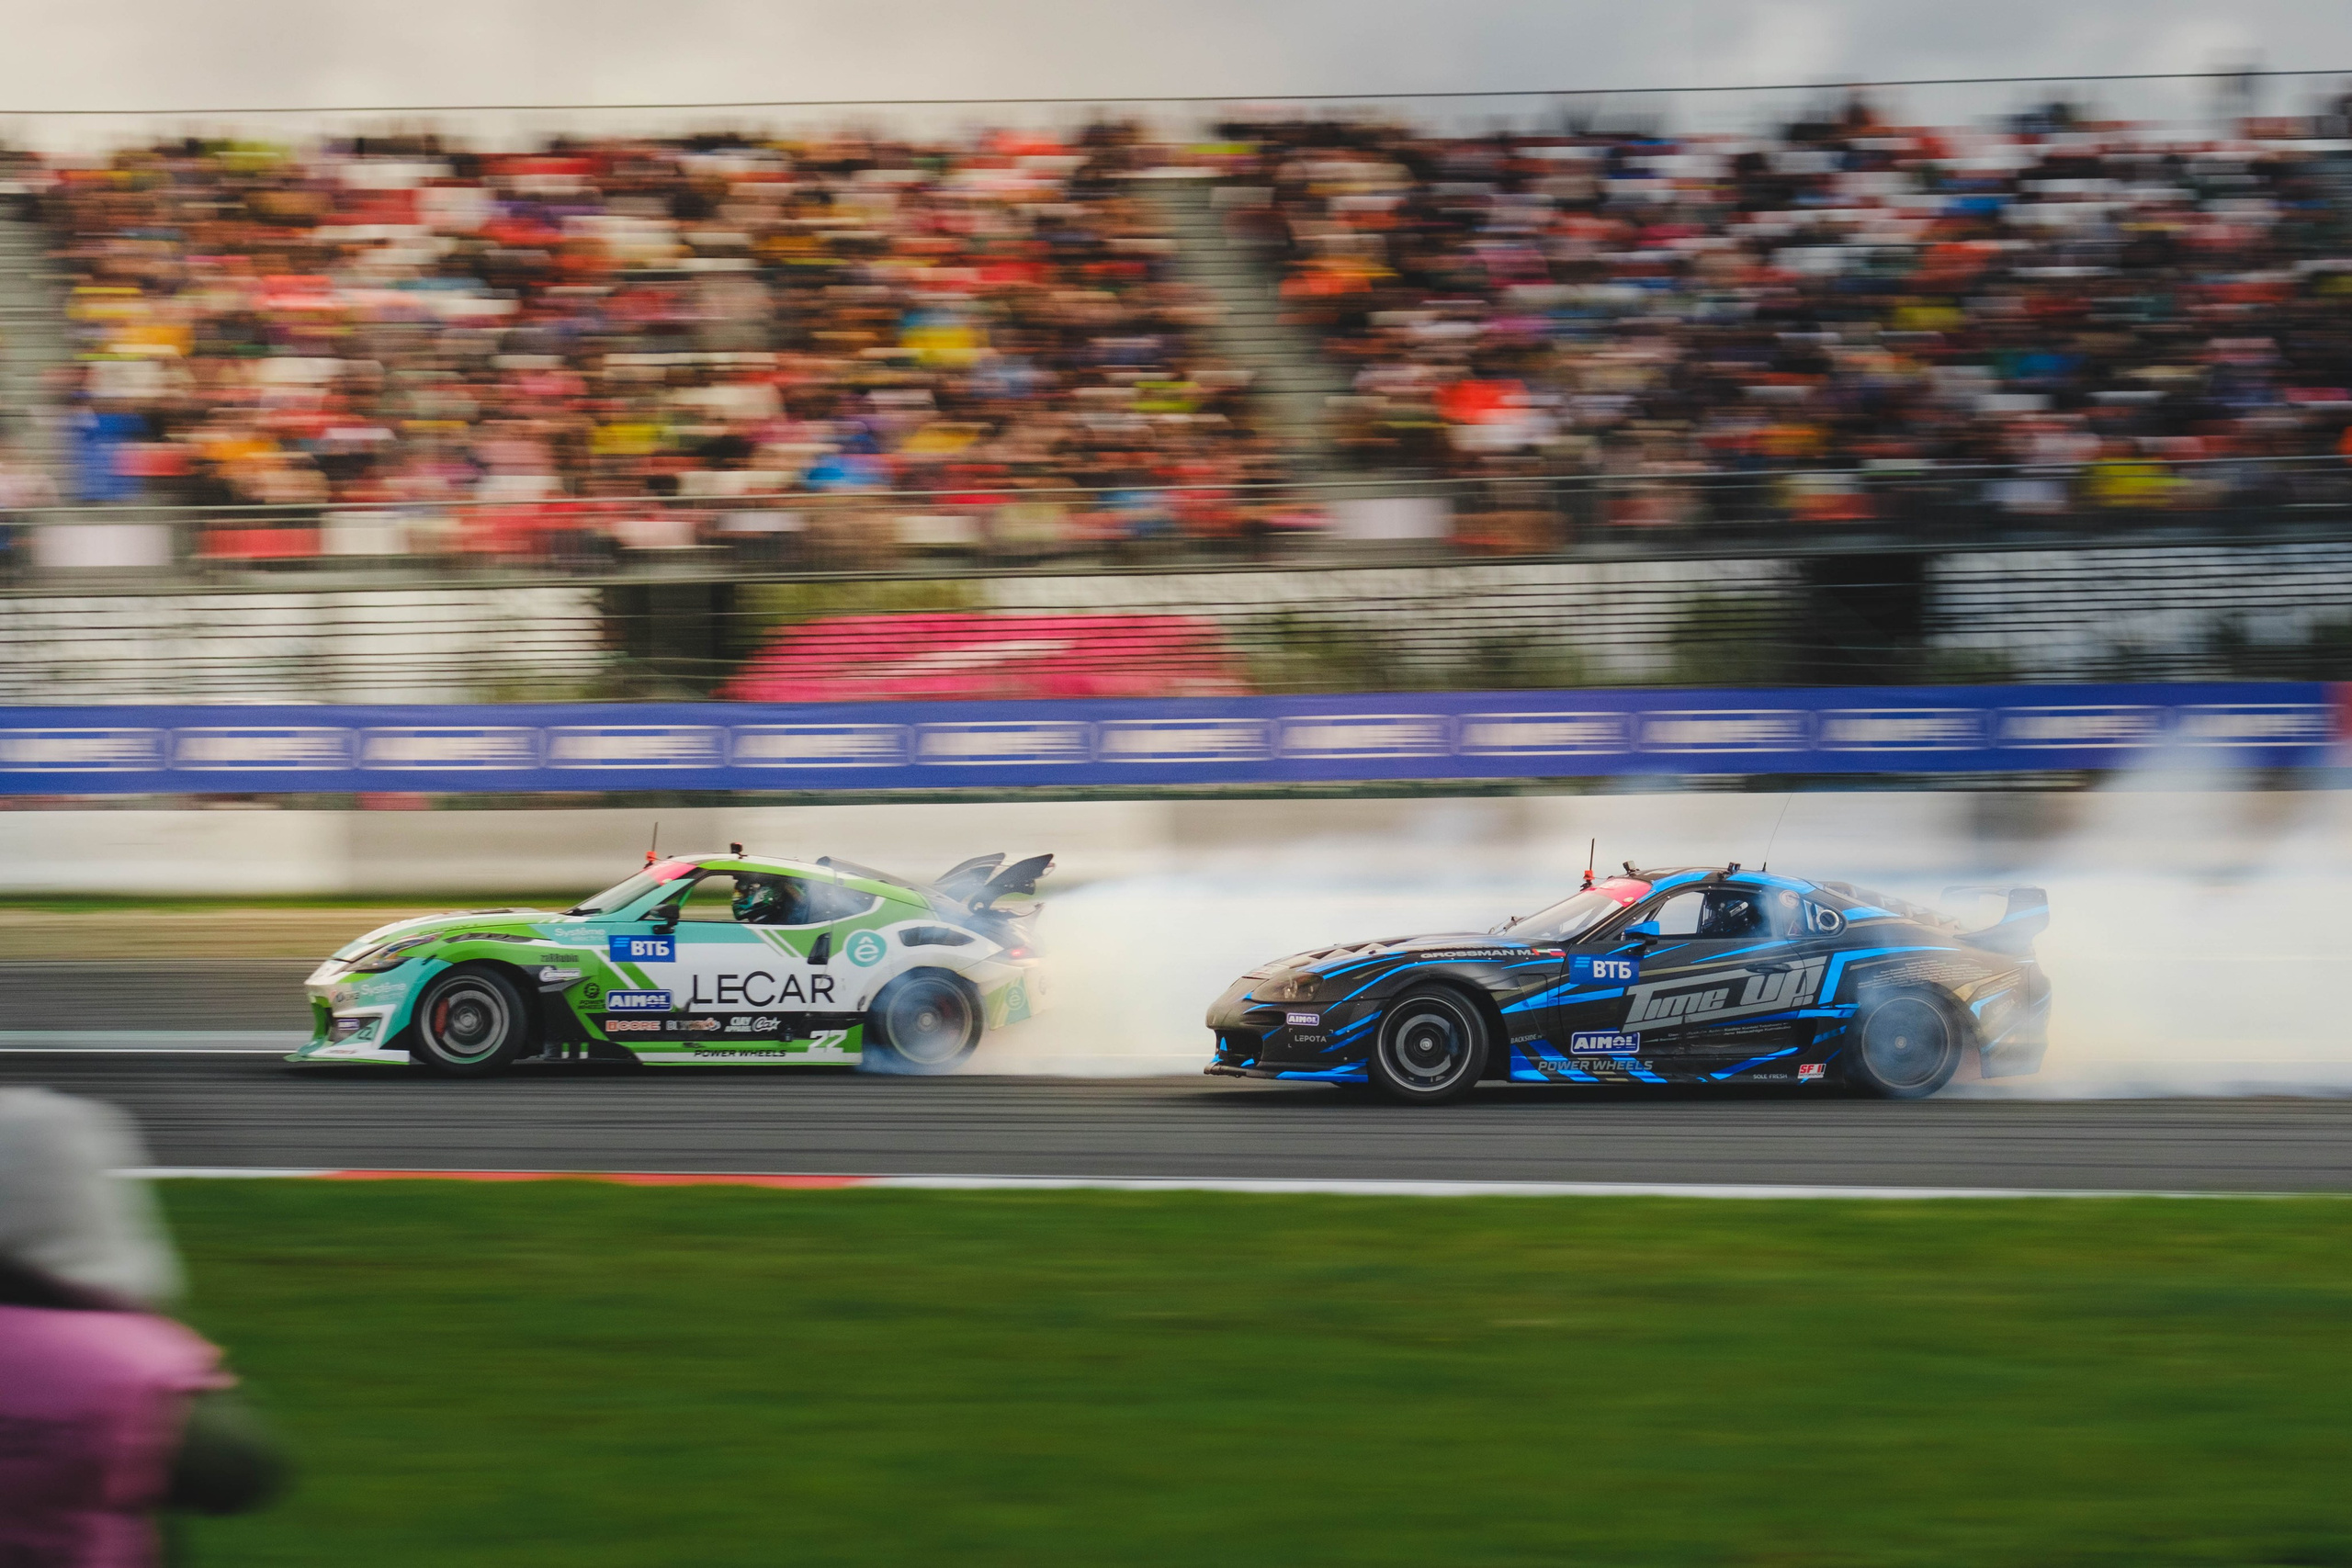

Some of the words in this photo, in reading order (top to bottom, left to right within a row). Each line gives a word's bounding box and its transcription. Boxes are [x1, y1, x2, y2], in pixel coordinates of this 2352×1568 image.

[630, 941, 671, 956] ВТБ
[1420, 950, 1515, 959] GROSSMAN
[1592, 960, 1632, 979] ВТБ
[693, 970, 836, 1008] LECAR
[609, 995, 670, 1008] AIMOL
[1288, 1015, 1317, 1023] AIMOL
[807, 1029, 848, 1054] 22
[1295, 1034, 1327, 1043] LEPOTA
[1573, 1035, 1636, 1050] AIMOL
[694, 1049, 737, 1057] POWER
[1537, 1060, 1589, 1071] POWER
[1592, 1060, 1654, 1070] WHEELS
